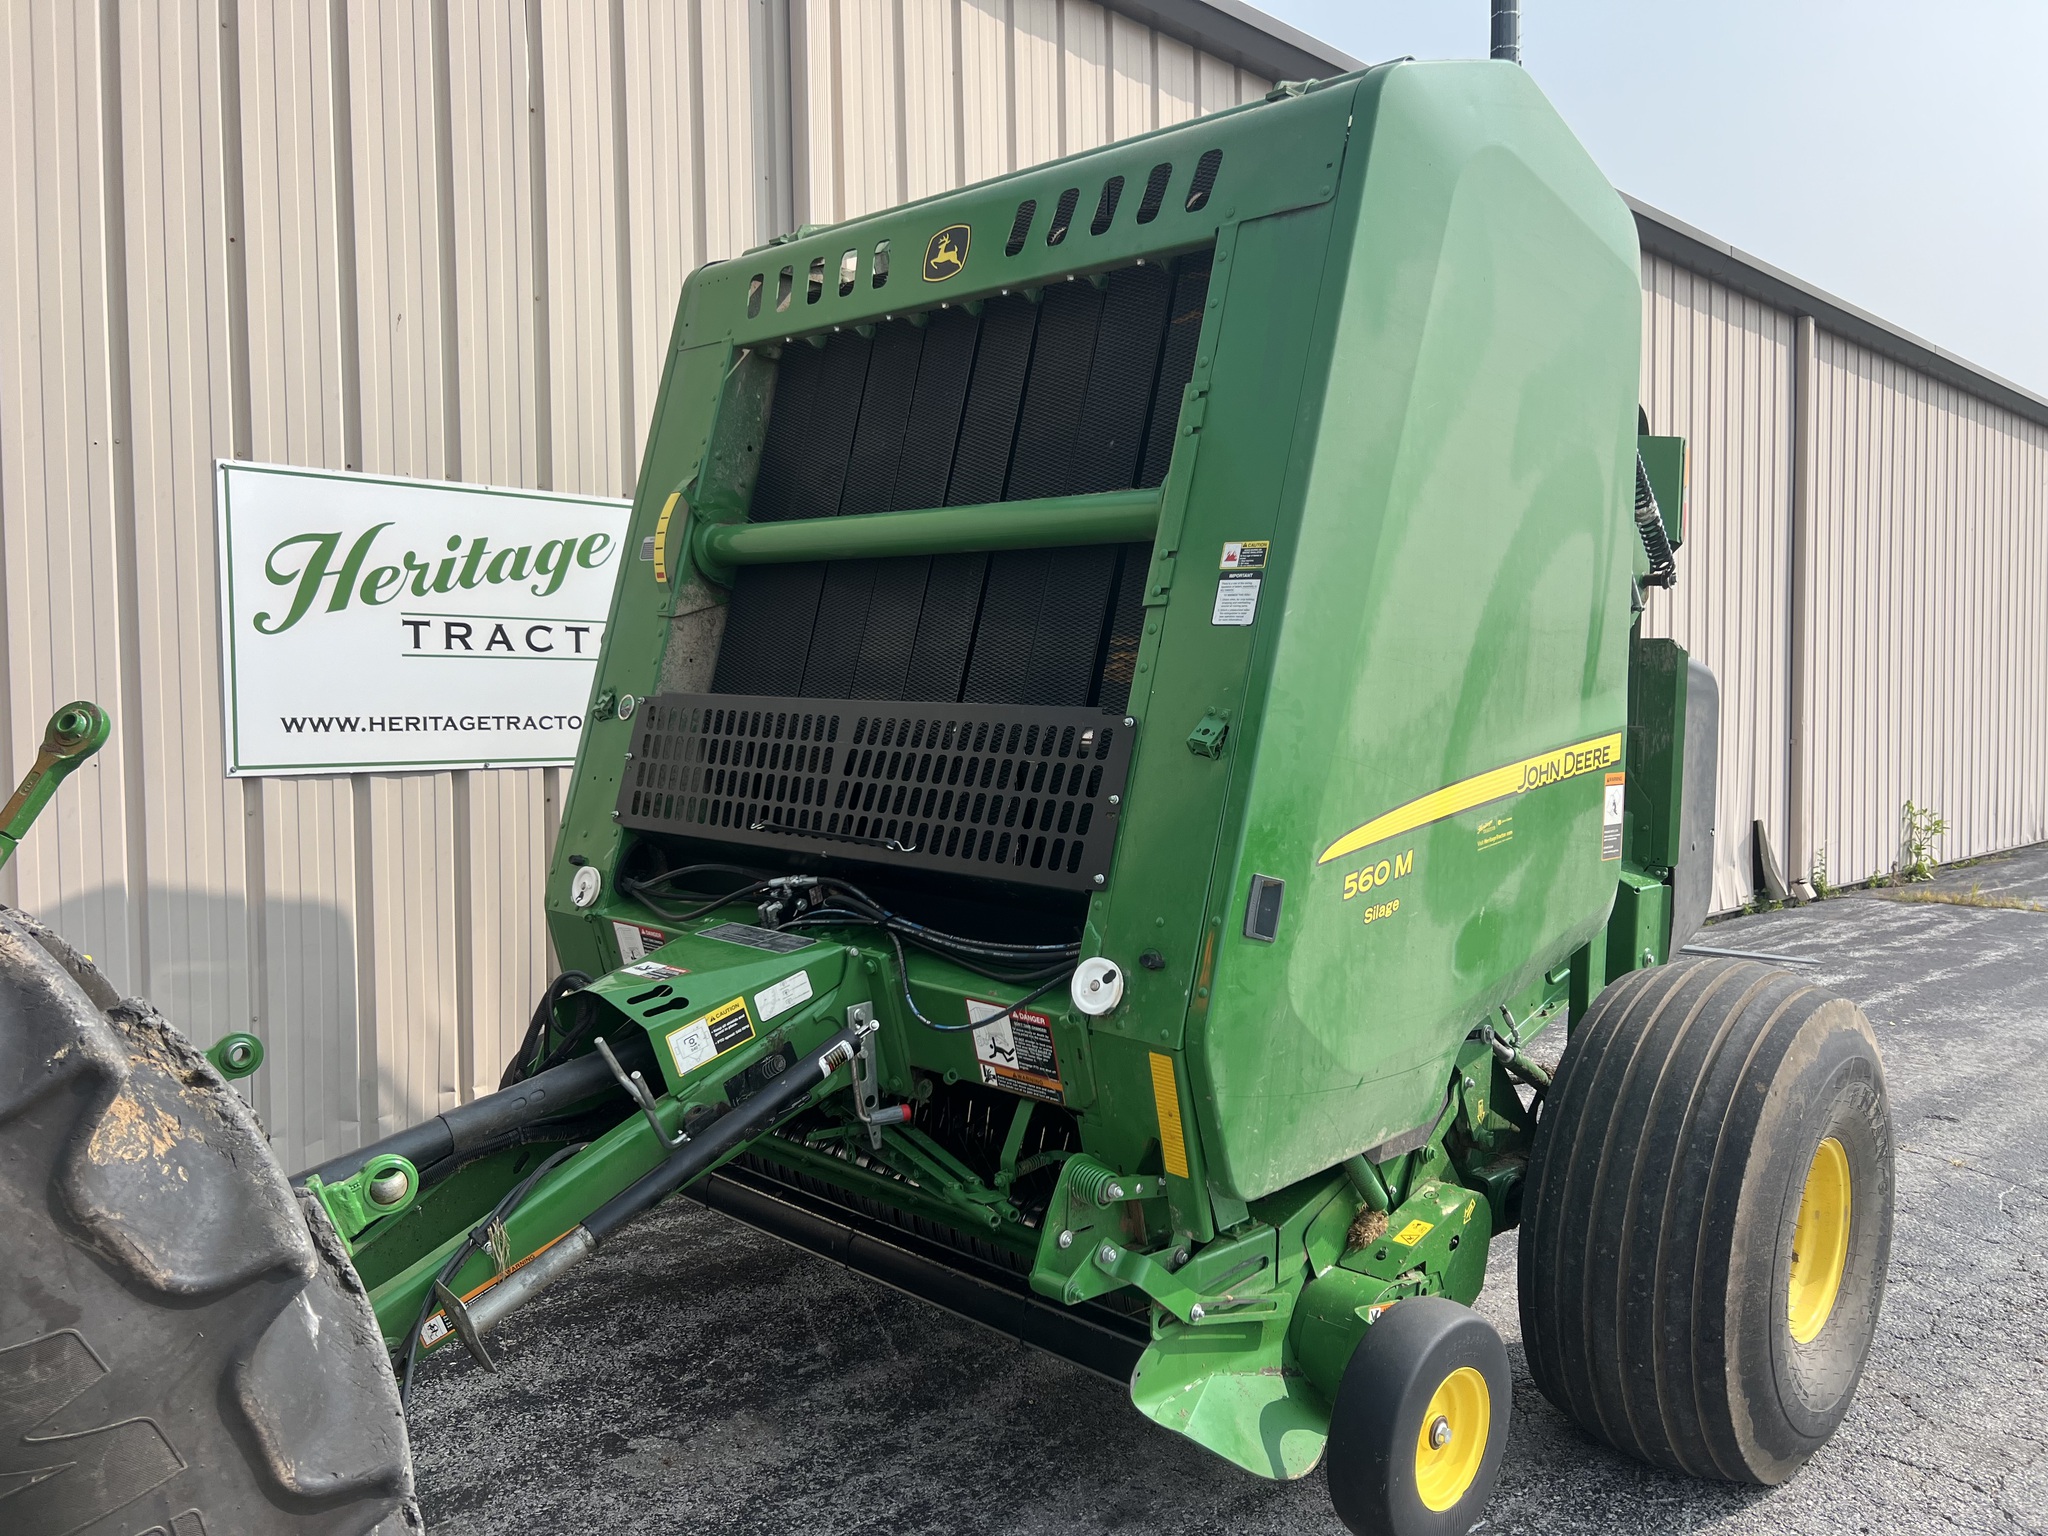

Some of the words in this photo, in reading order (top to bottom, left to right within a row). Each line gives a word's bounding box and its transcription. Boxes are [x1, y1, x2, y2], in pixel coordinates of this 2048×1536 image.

[253, 522, 616, 635] Heritage
[402, 619, 605, 654] TRACT
[280, 715, 585, 734] WWW.HERITAGETRACTO
[1517, 759, 1561, 791] JOHN
[1564, 745, 1611, 776] DEERE
[1343, 859, 1391, 900] 560
[1394, 849, 1414, 879] M
[1363, 899, 1400, 924] Silage
[715, 1003, 740, 1019] CAUTION
[1018, 1012, 1046, 1025] DANGER
[1016, 1072, 1044, 1085] WARNING
[505, 1254, 536, 1275] WARNING
